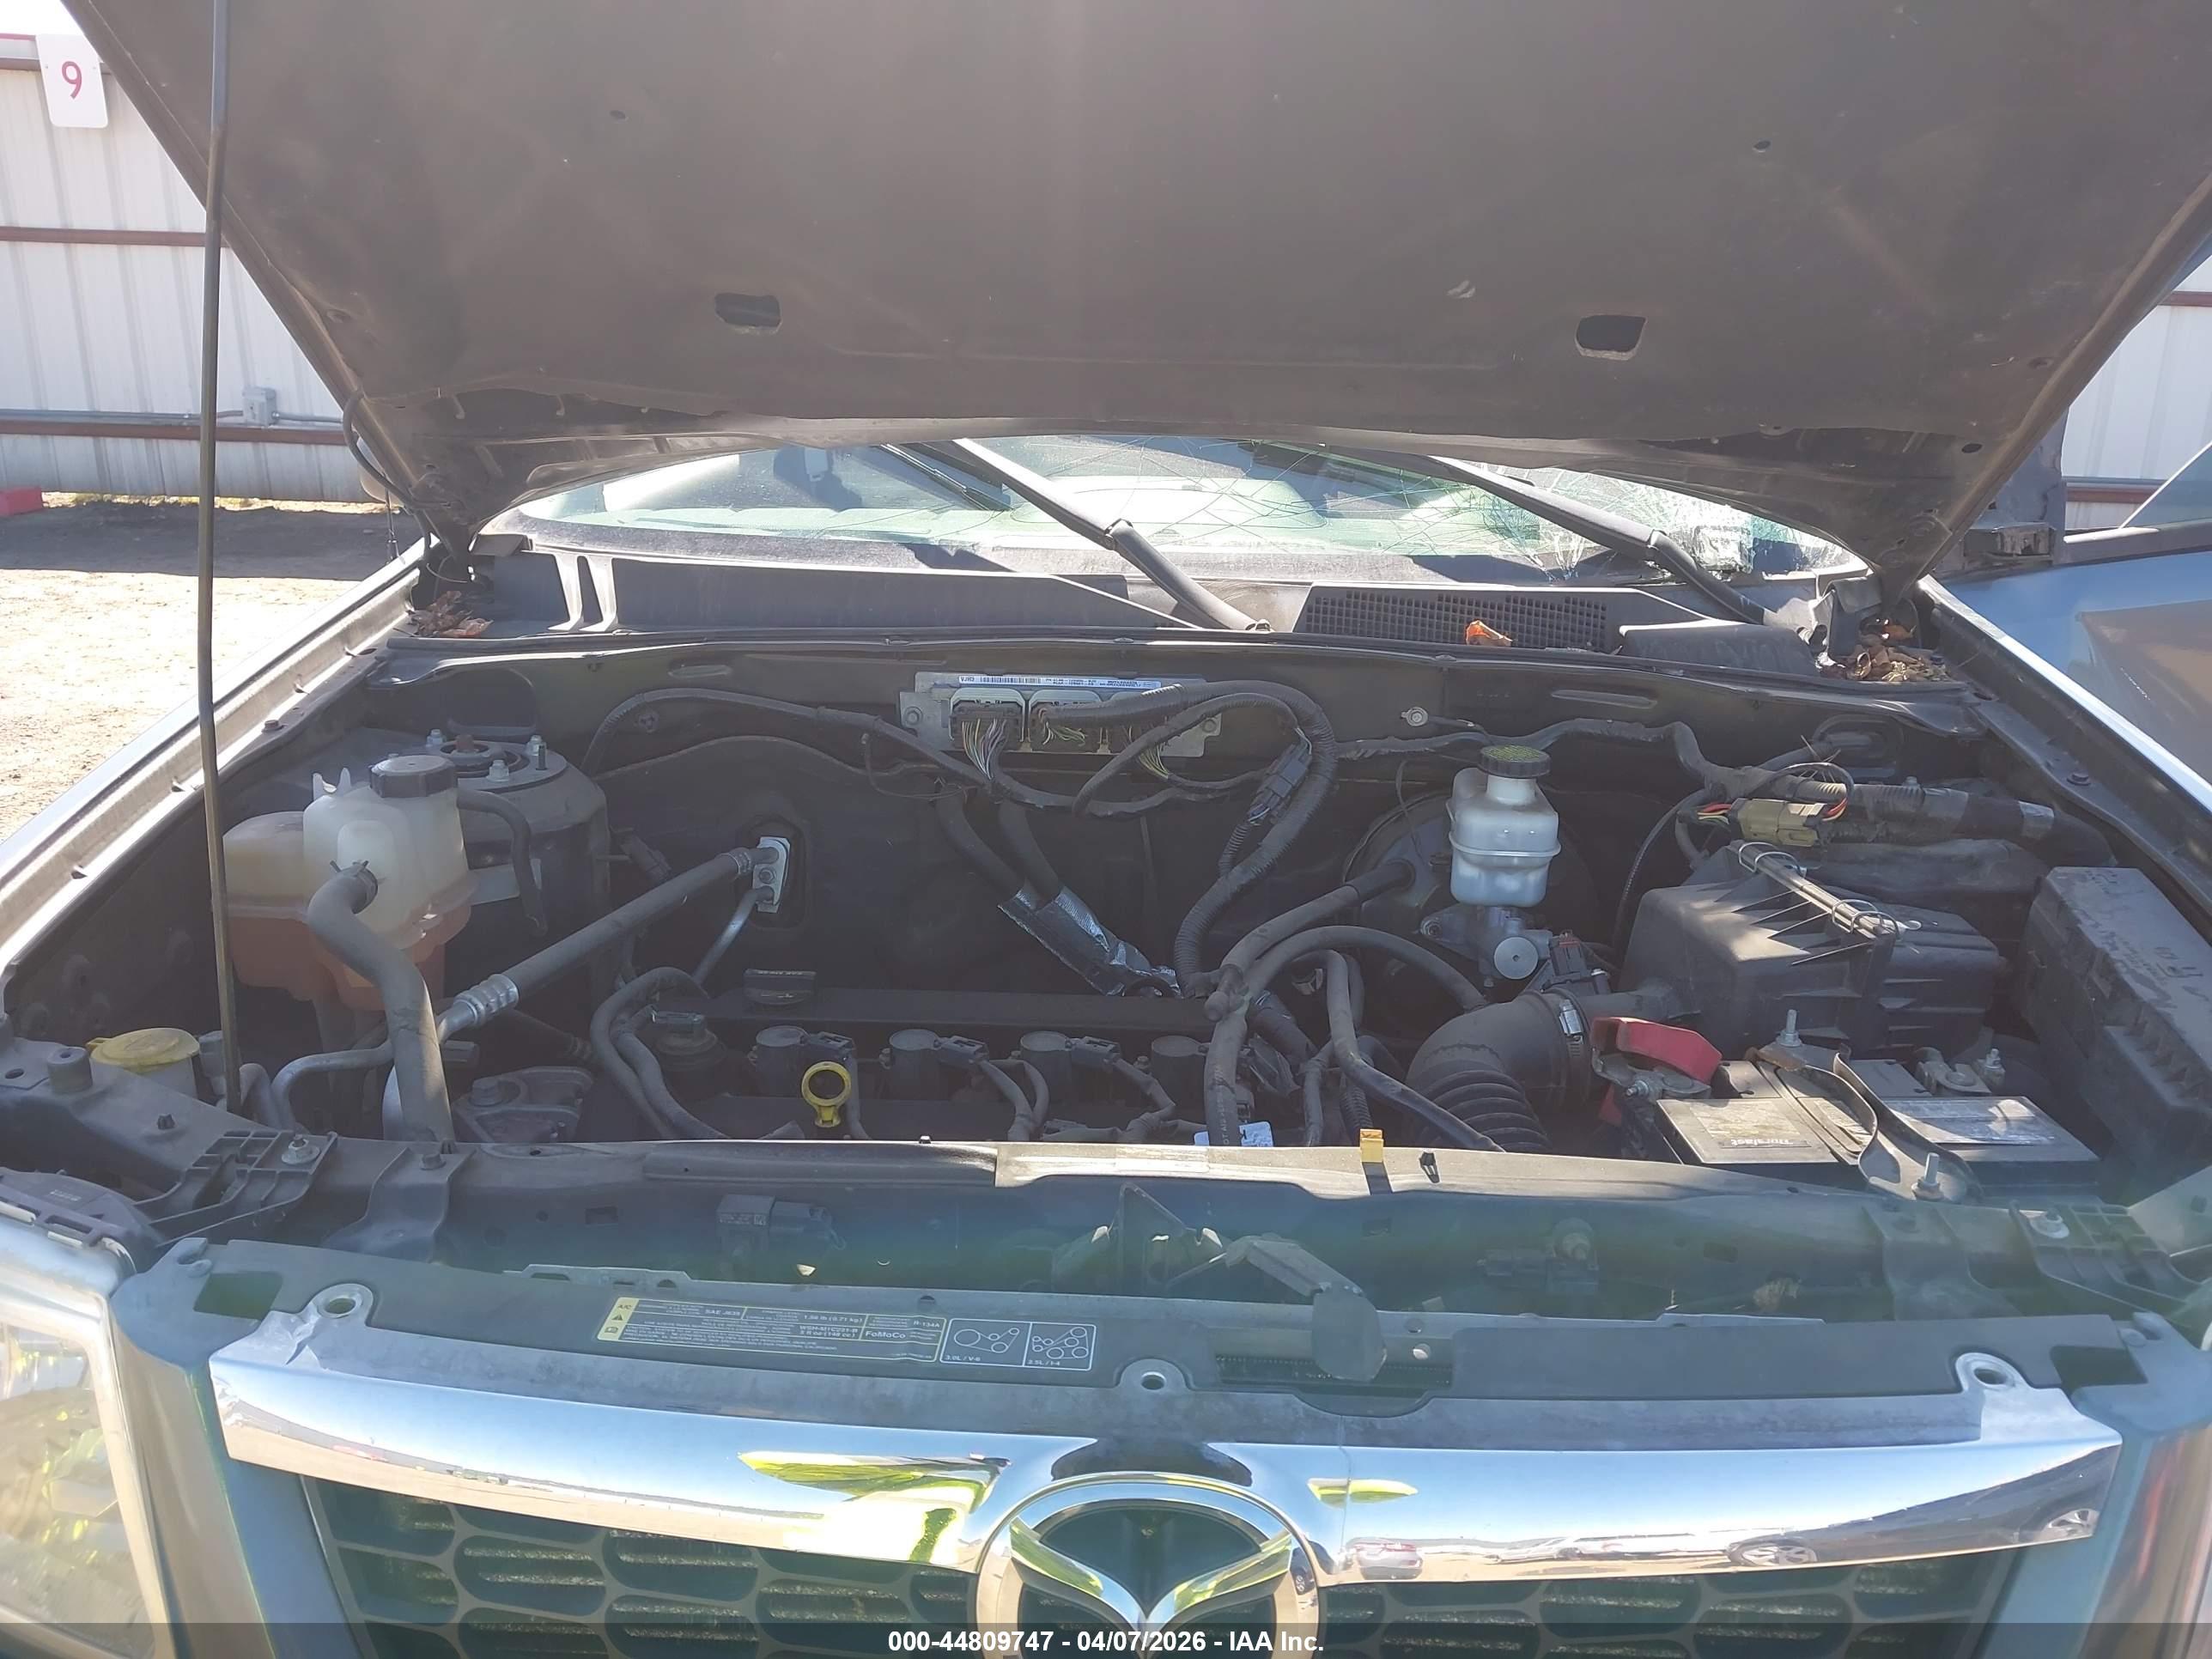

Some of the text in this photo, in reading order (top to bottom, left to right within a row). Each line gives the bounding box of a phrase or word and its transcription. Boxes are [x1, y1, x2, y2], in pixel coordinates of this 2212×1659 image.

[62, 61, 82, 100] 9
[913, 1320, 940, 1328] R-134A
[865, 1330, 906, 1339] FoMoCo
